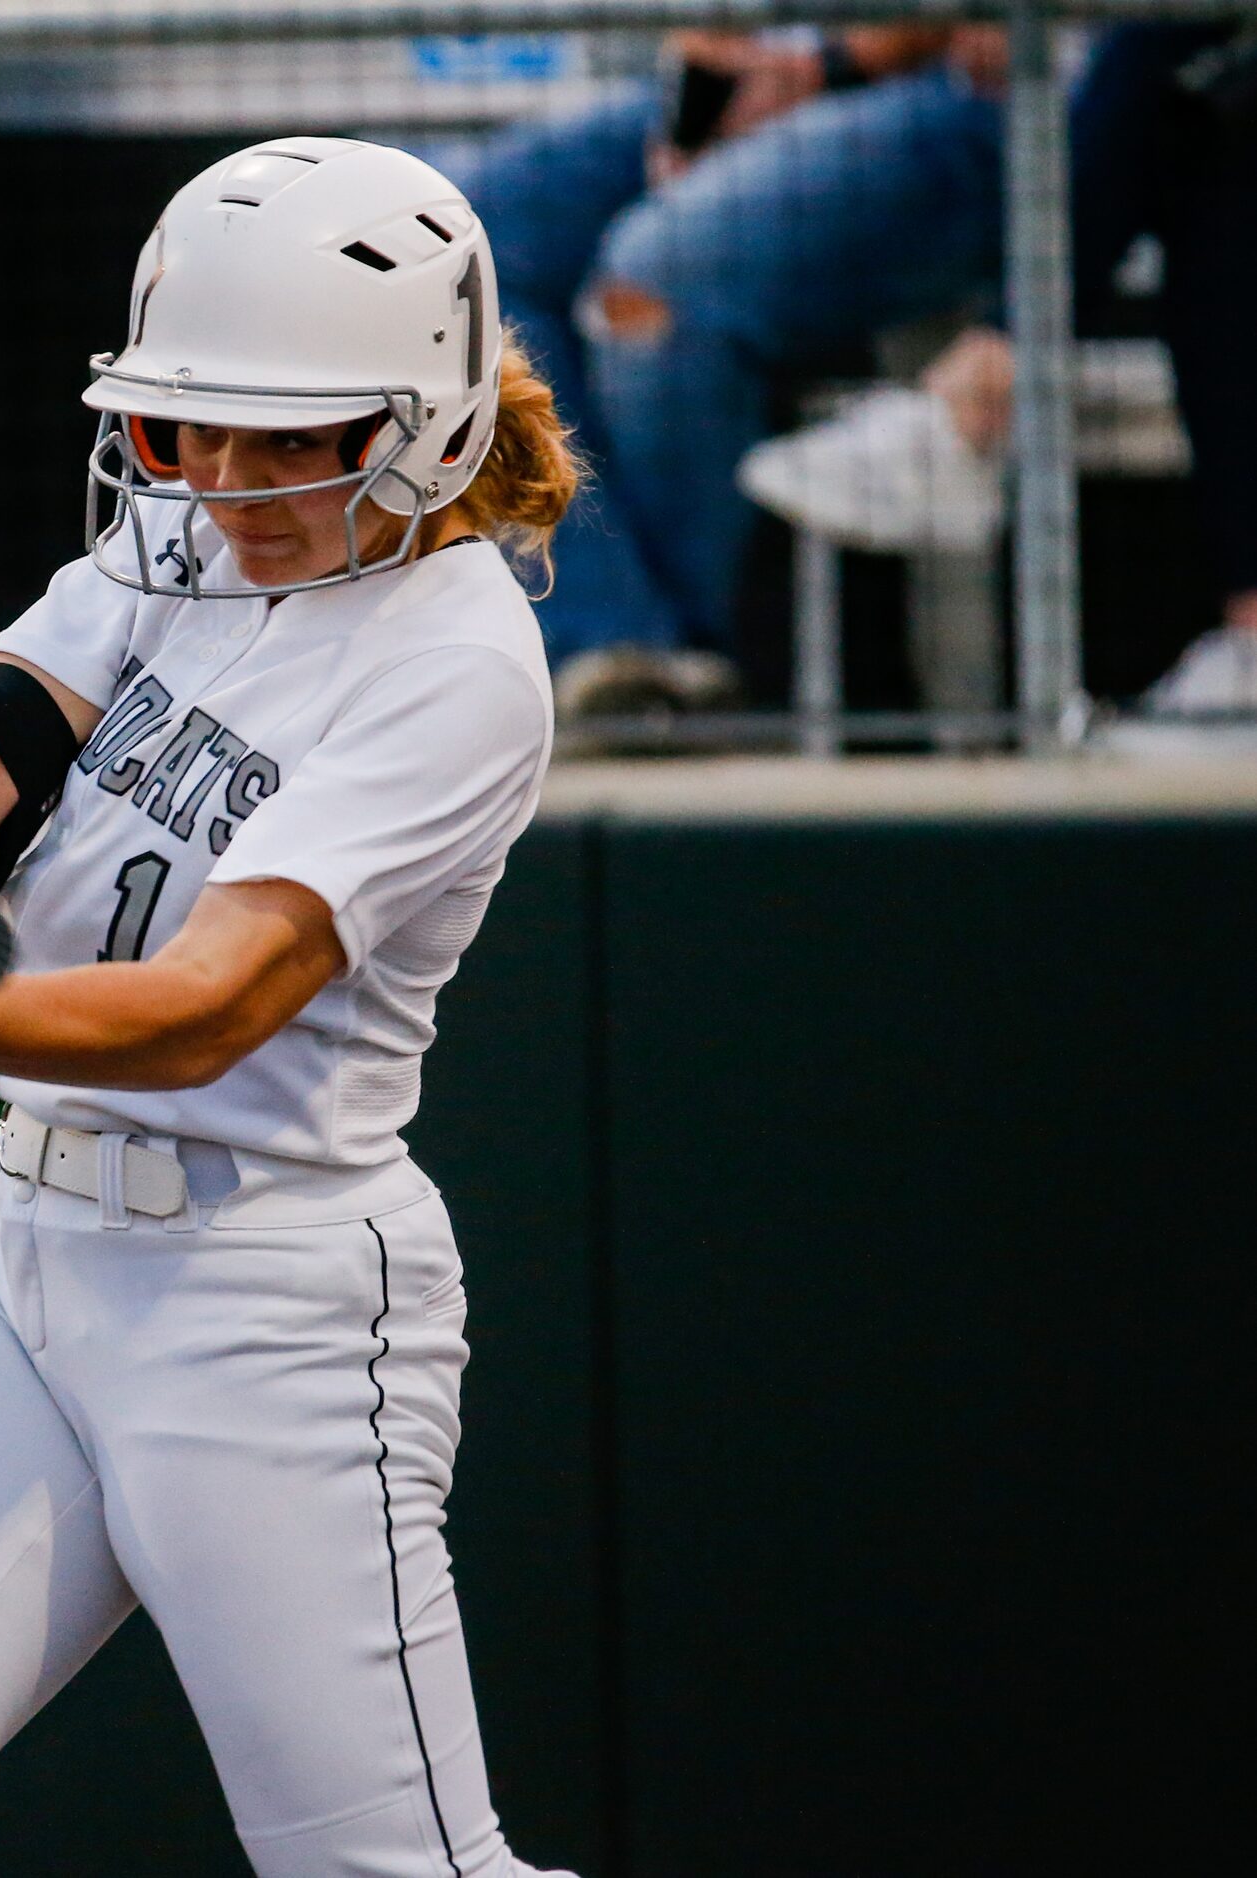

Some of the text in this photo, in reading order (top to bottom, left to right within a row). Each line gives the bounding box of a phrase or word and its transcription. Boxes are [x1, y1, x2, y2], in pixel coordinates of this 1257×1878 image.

[452, 249, 484, 394] 1
[77, 655, 280, 855] DCATS
[97, 850, 171, 962] 1
